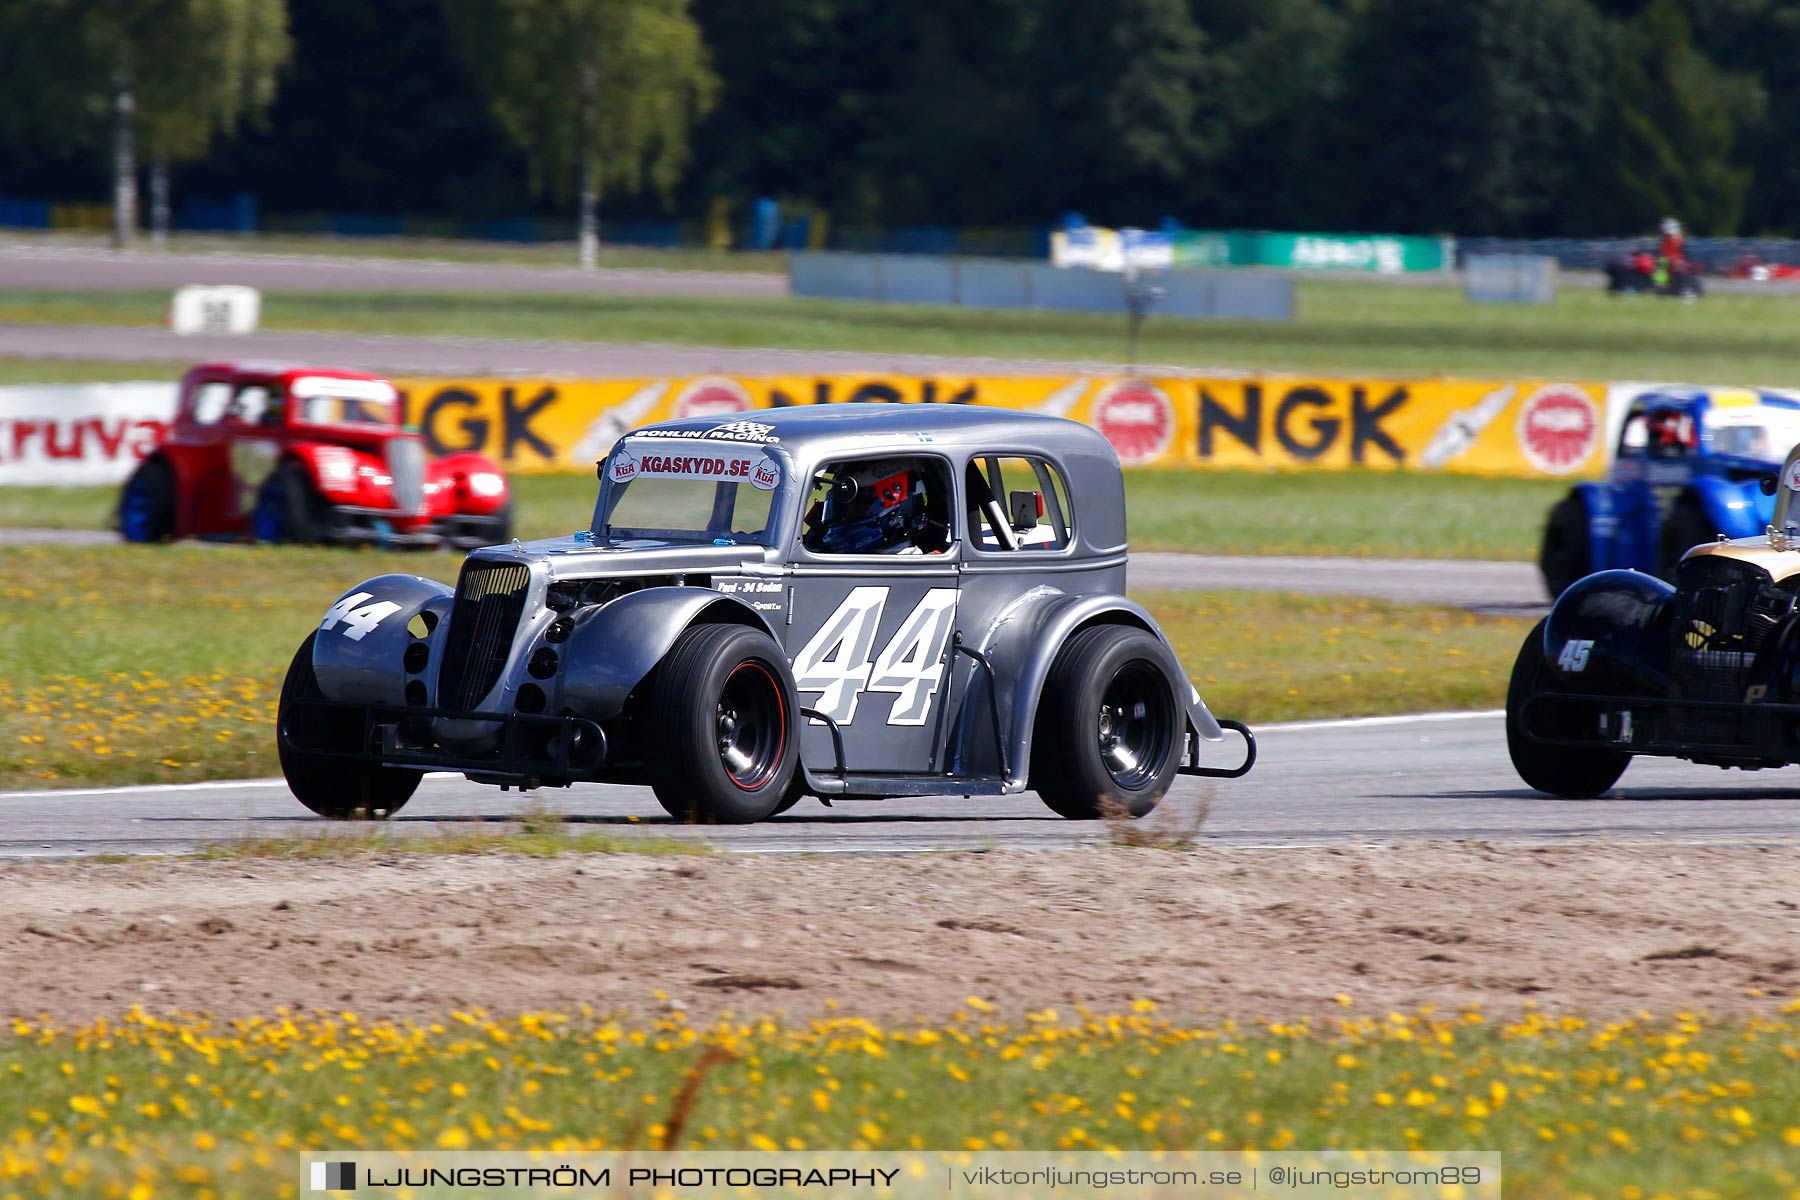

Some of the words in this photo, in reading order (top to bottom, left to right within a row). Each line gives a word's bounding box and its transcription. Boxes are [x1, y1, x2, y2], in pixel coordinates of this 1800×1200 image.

[402, 384, 558, 460] GK
[634, 430, 703, 439] BOHLIN
[709, 431, 781, 444] RACING
[1196, 384, 1413, 464] NGK
[0, 416, 172, 462] ruva
[615, 463, 635, 477] KGA
[641, 456, 751, 477] KGASKYDD.SE
[754, 468, 775, 484] KGA
[718, 582, 737, 593] Ford
[317, 591, 402, 642] 44
[793, 585, 963, 727] 44
[1558, 639, 1595, 672] 45
